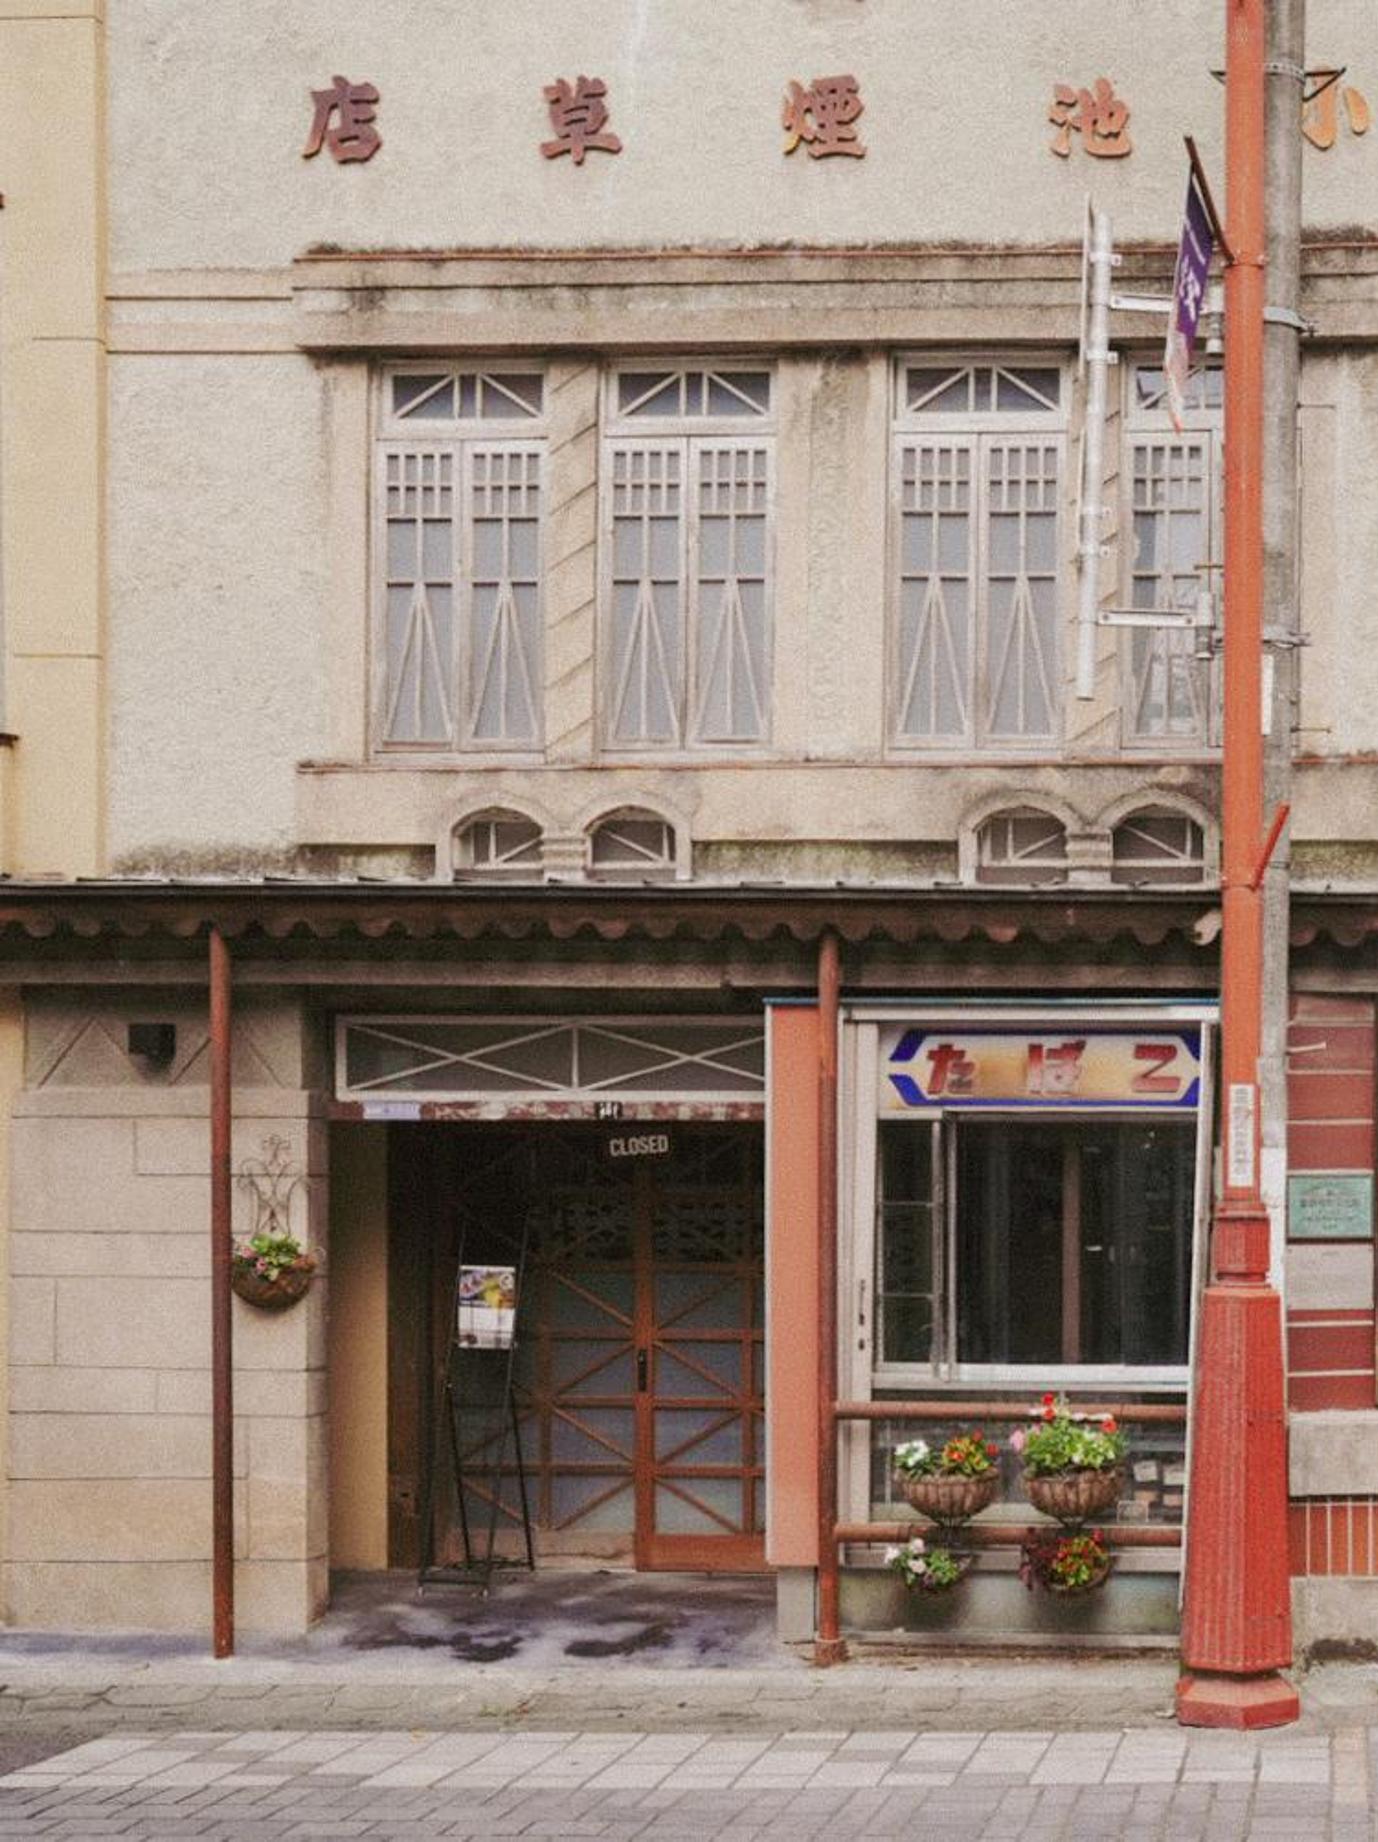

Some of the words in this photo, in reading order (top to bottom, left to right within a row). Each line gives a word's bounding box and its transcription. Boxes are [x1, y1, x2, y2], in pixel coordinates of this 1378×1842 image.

[927, 1040, 1181, 1096] たばこ
[609, 1134, 669, 1156] CLOSED
